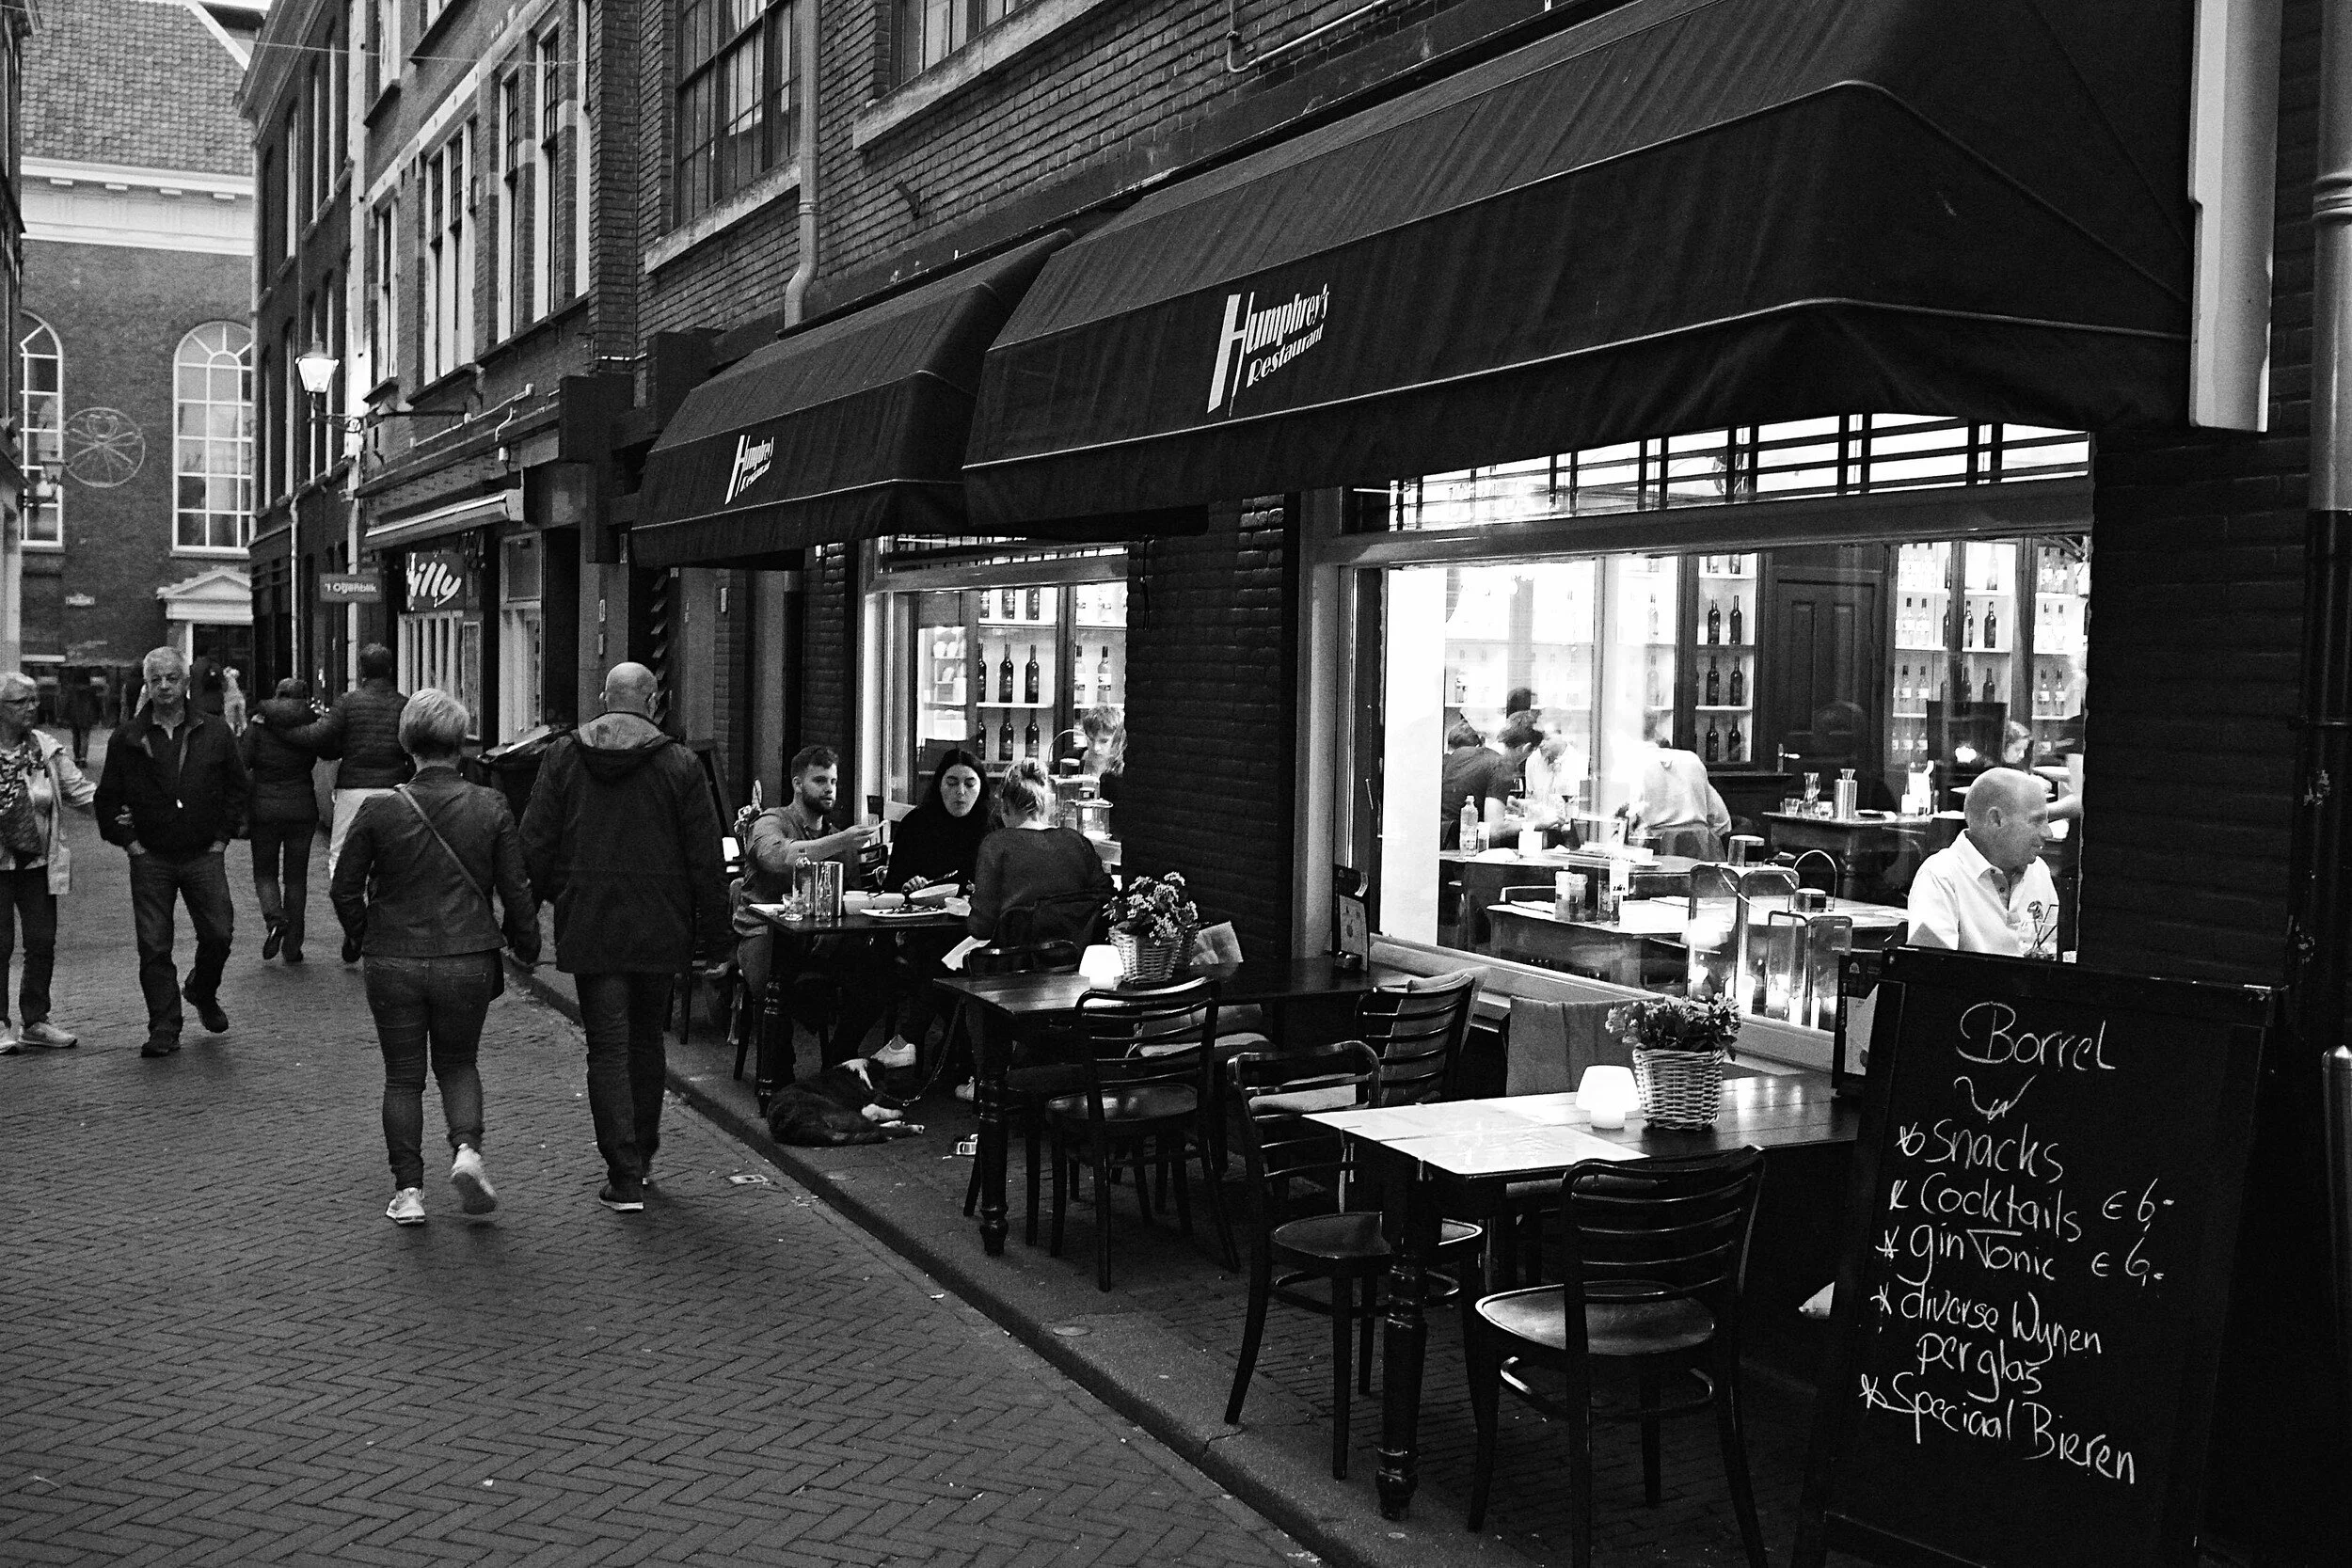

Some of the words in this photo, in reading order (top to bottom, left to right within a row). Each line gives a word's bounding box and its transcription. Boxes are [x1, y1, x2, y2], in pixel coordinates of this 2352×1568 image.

[1247, 323, 1324, 388] Restaurant
[1956, 1002, 2116, 1070] Borrel
[1925, 1118, 2063, 1183] Snacks
[1920, 1172, 2082, 1242] Cocktails
[1965, 1228, 2056, 1281] Tonic
[1900, 1282, 1999, 1334] diverse
[1916, 1332, 1972, 1375] per
[1966, 1338, 2042, 1403] glas
[1885, 1371, 2014, 1445] Speciaal
[2022, 1402, 2136, 1485] Bieren
